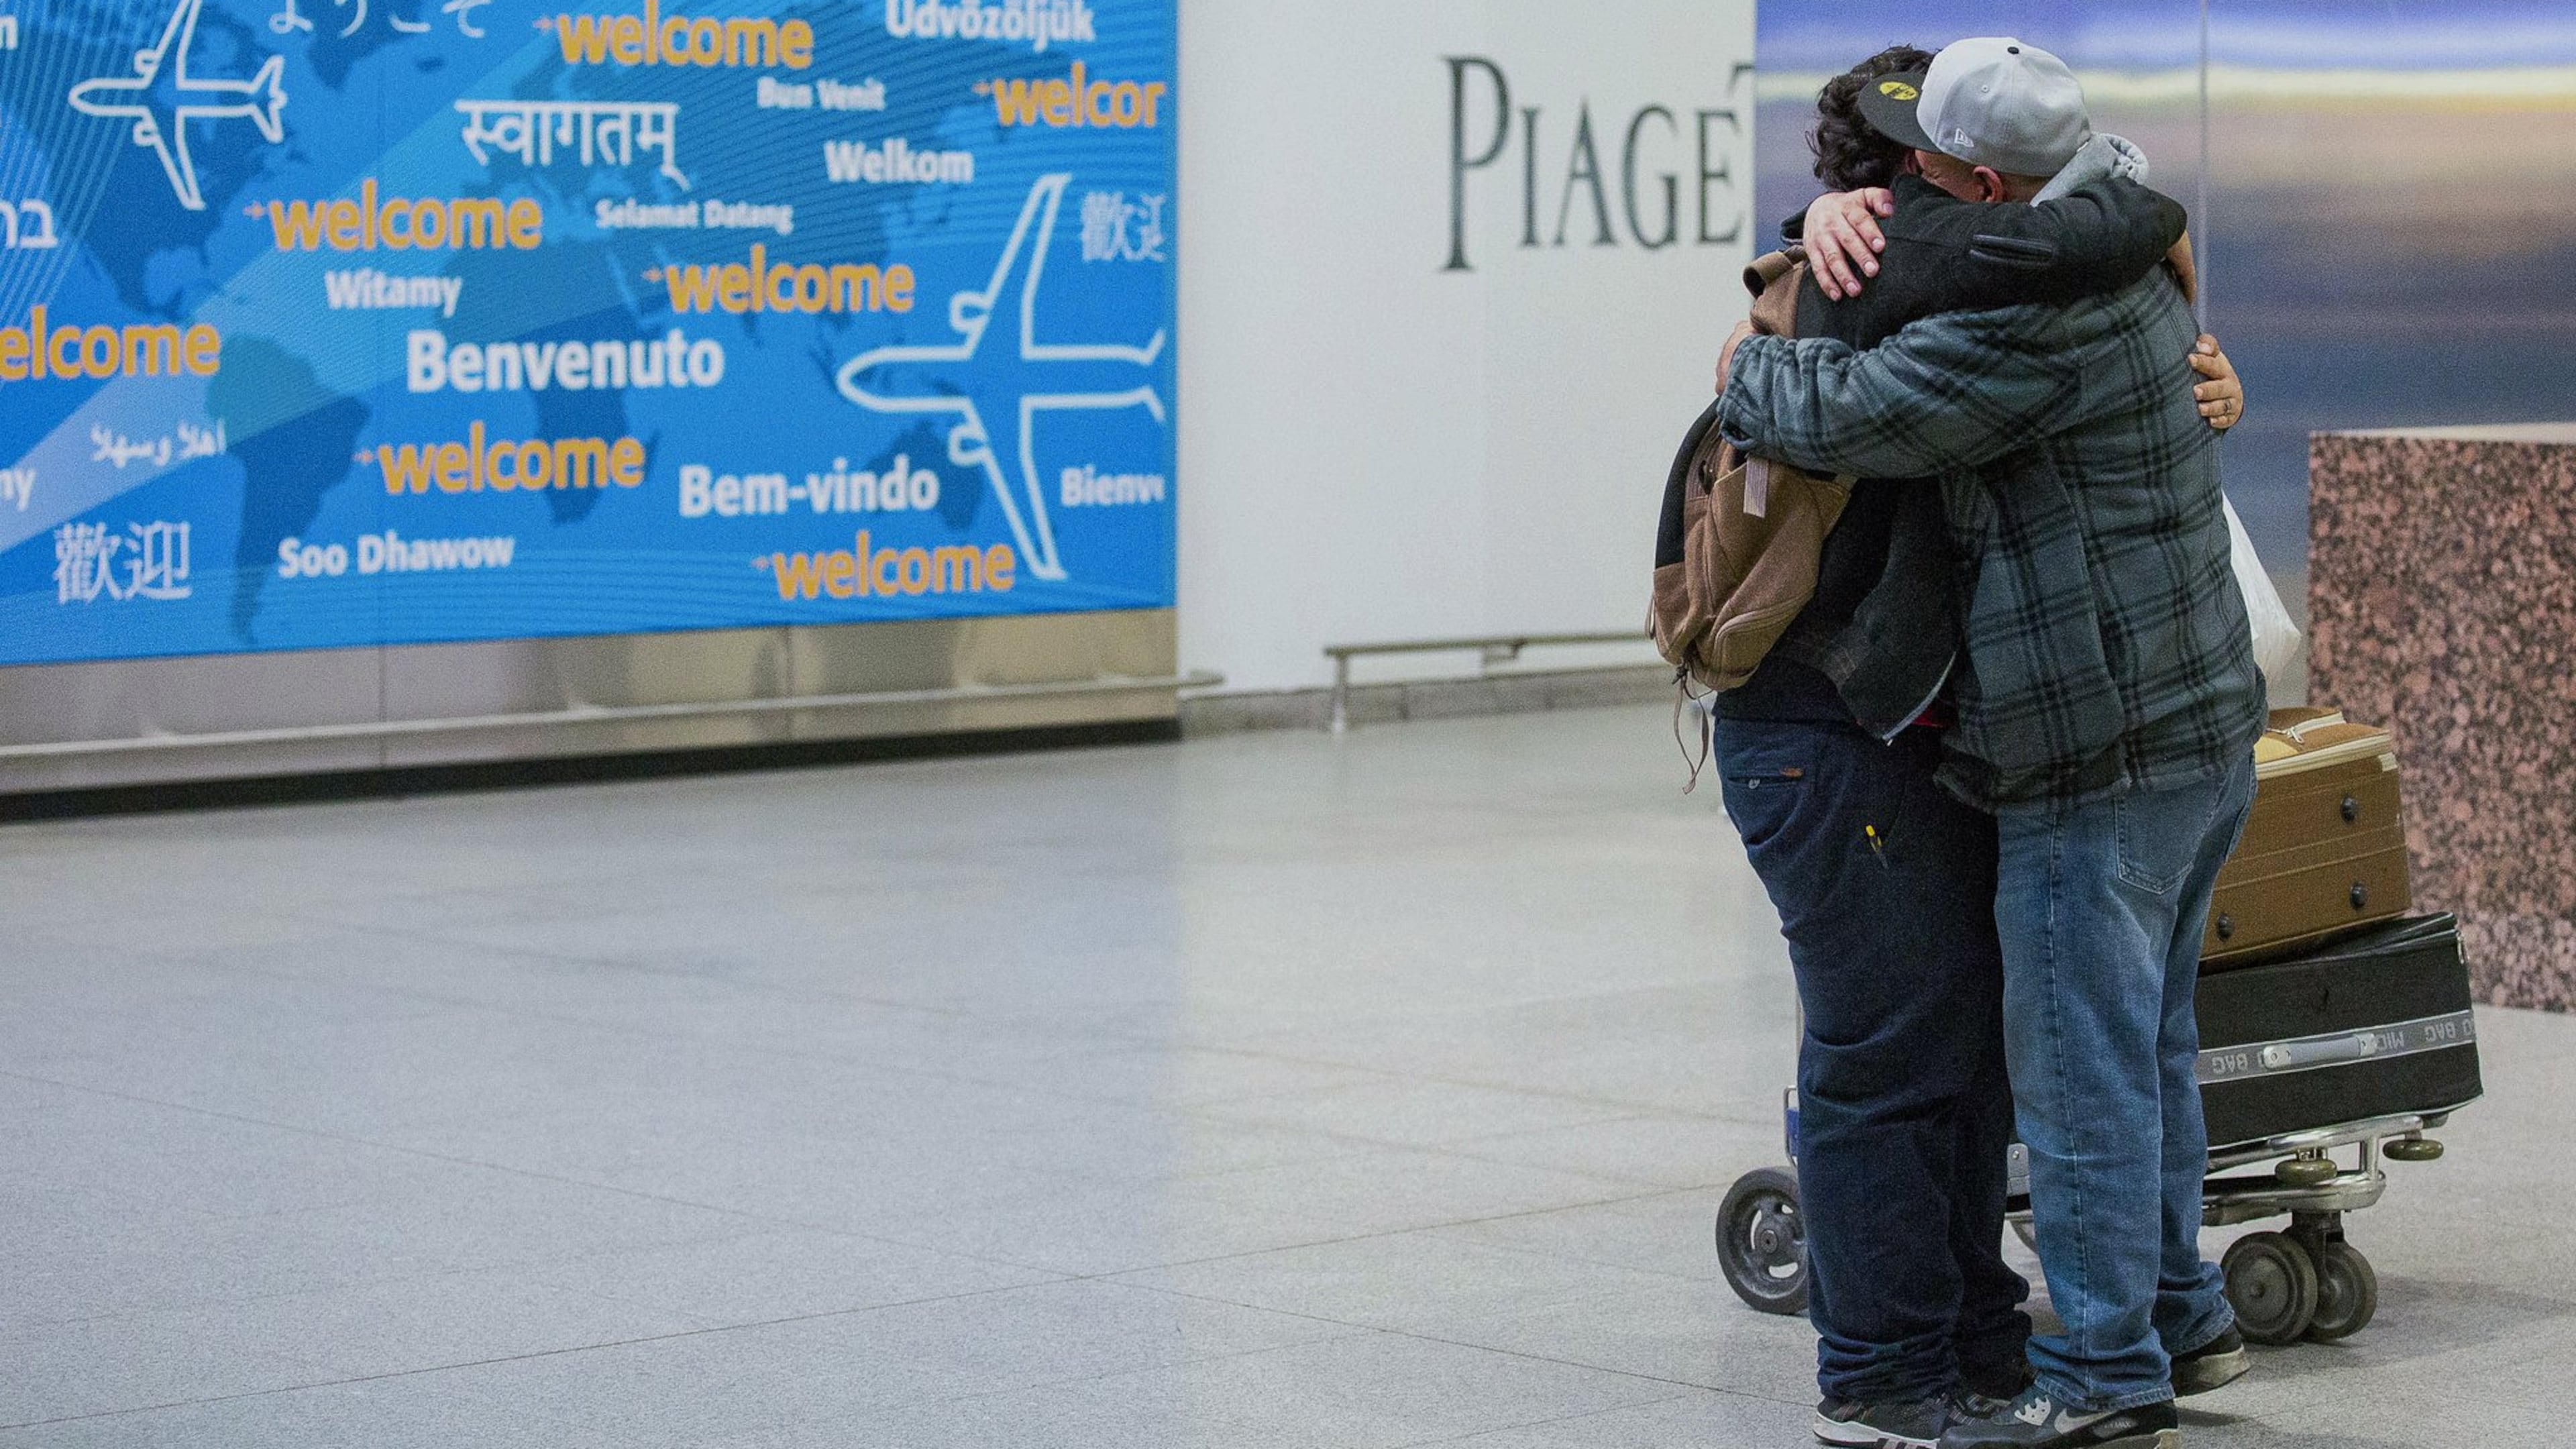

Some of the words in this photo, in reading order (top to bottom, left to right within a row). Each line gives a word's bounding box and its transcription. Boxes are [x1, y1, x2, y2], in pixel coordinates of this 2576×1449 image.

[555, 0, 813, 68] welcome
[454, 100, 688, 188] स्वागतम्
[824, 139, 973, 182] Welkom
[268, 178, 543, 252] welcome
[596, 199, 698, 228] Selamat
[704, 200, 793, 234] Datang
[325, 268, 461, 316] Witamy
[664, 244, 915, 313] welcome
[407, 329, 724, 392] Benvenuto
[376, 421, 645, 494] welcome
[680, 455, 938, 516] Bem-vindo
[53, 521, 193, 604] 歡迎
[279, 539, 347, 578] Soo
[358, 531, 514, 573] Dhawow
[771, 529, 1016, 599] welcome
